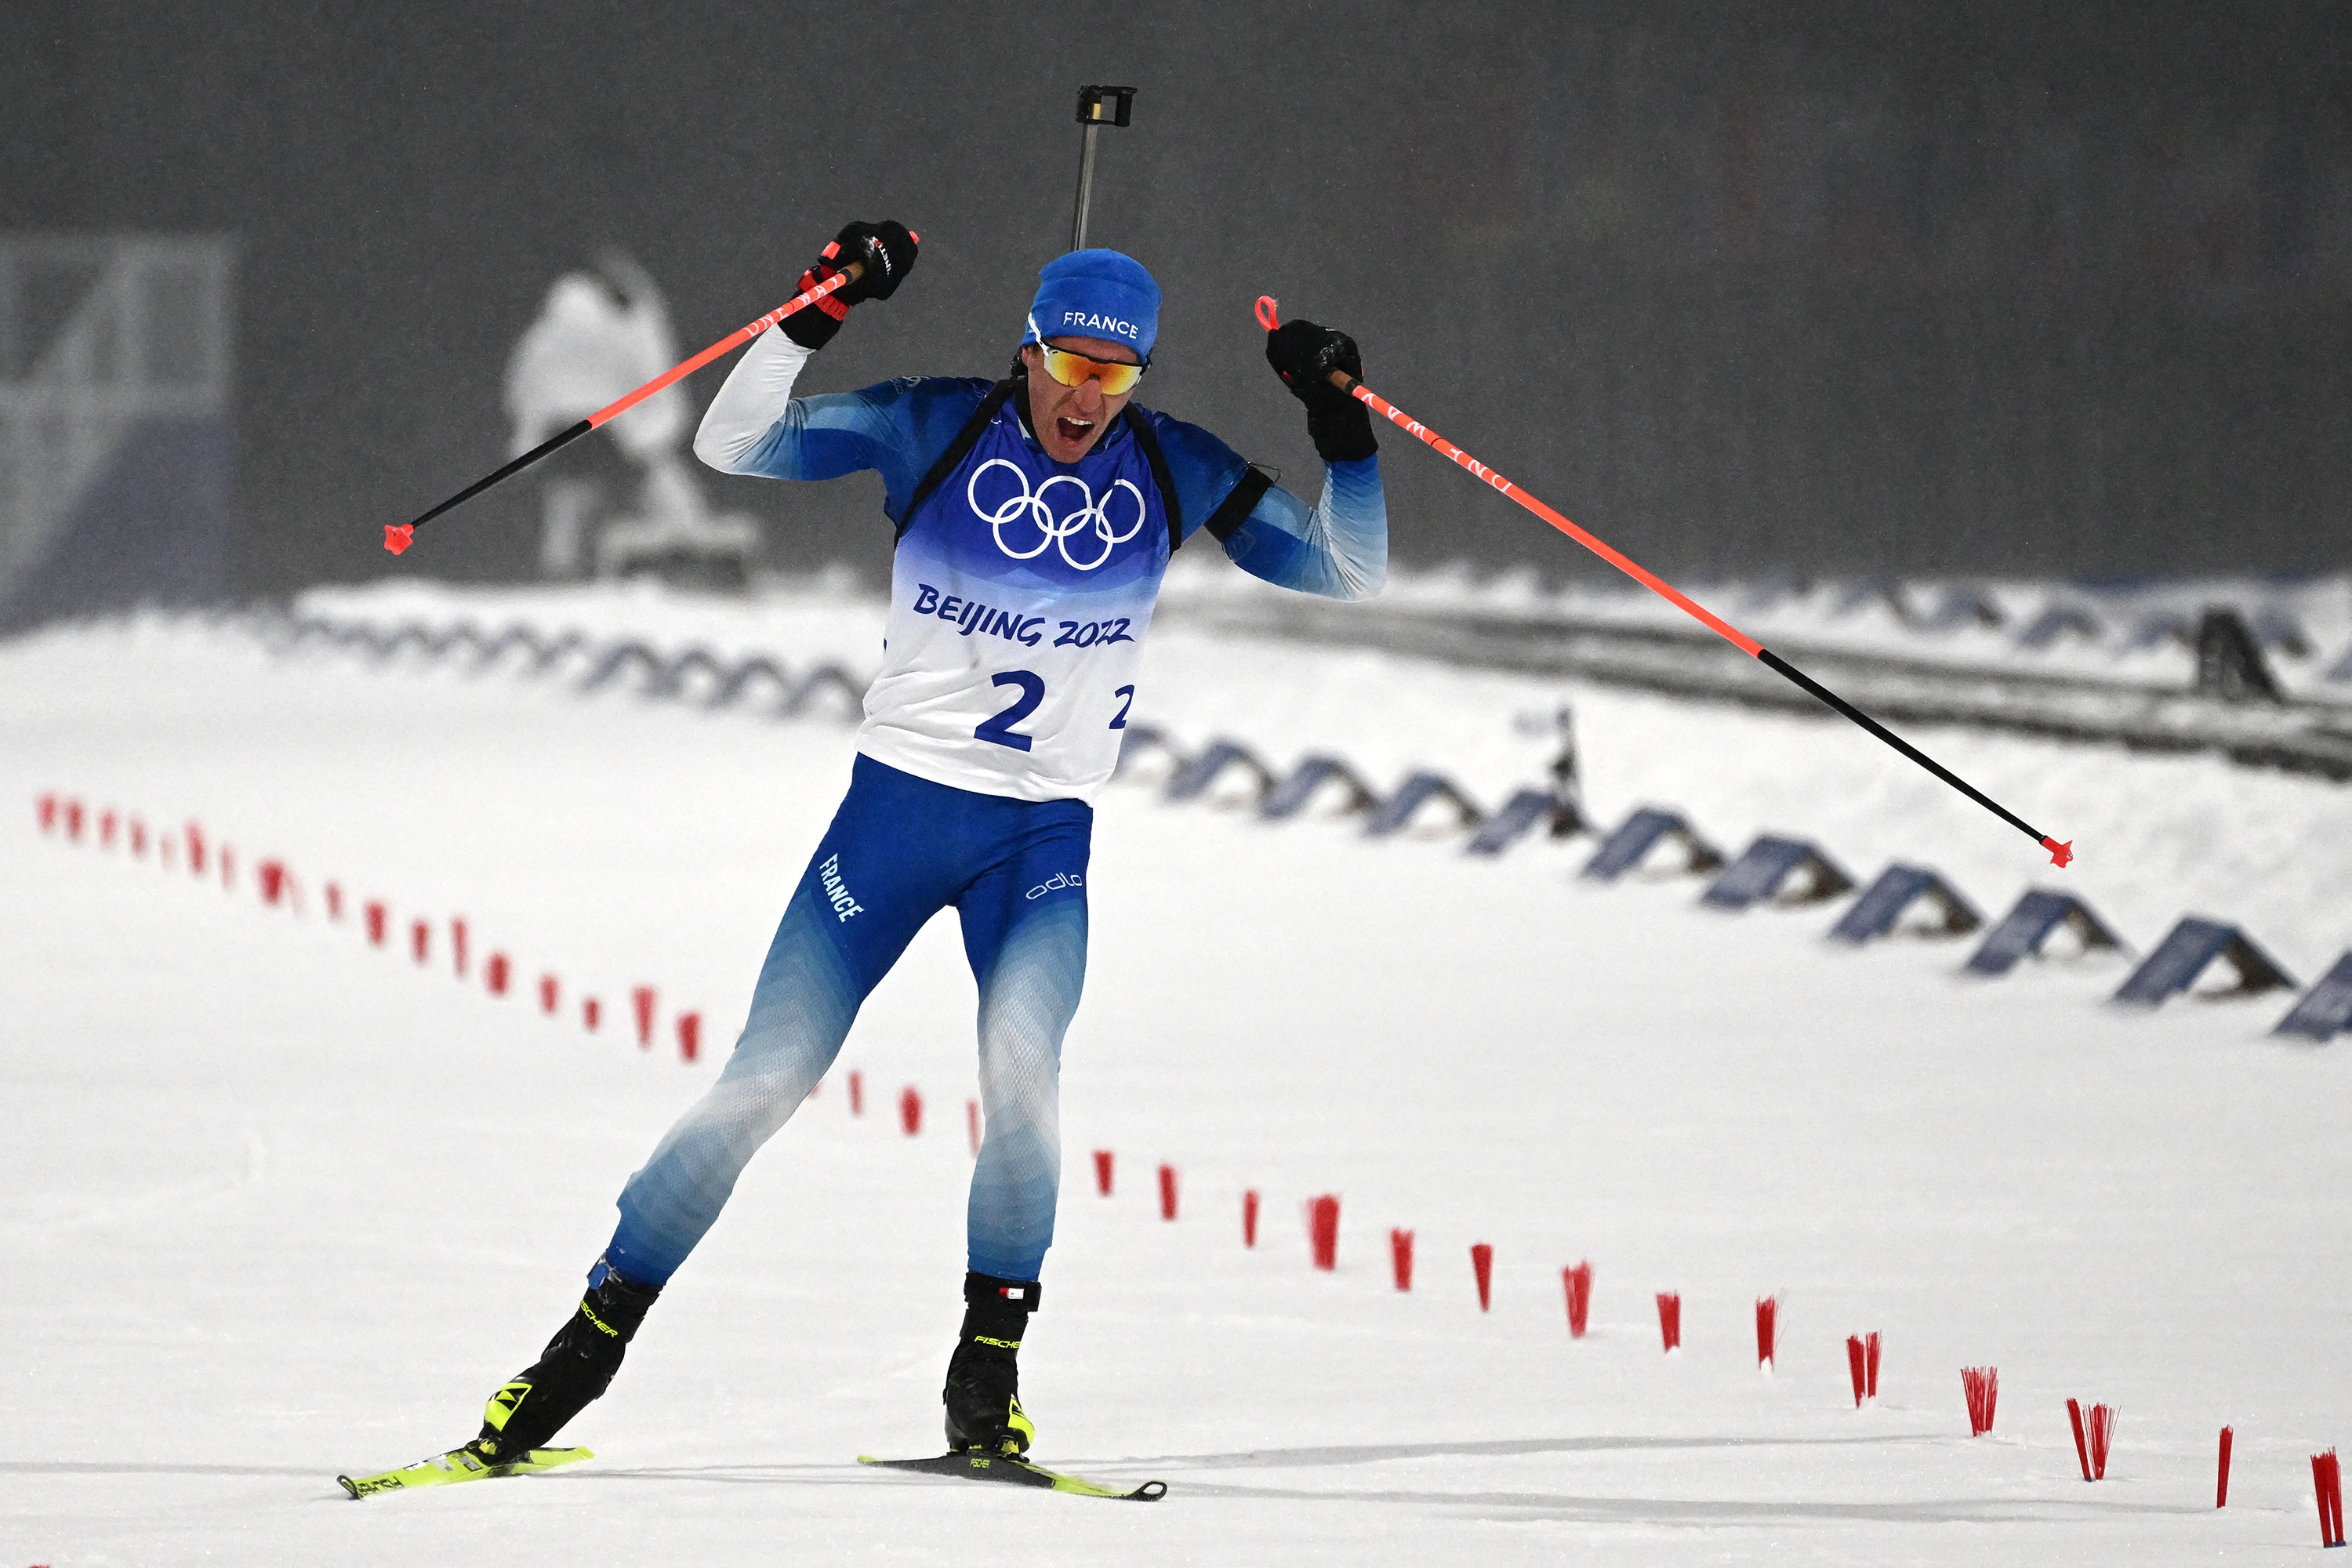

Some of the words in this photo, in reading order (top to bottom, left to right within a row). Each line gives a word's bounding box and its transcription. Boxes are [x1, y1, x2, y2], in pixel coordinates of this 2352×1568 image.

[1063, 311, 1138, 339] FRANCE
[913, 583, 1046, 648] BEIJING
[1053, 618, 1136, 648] 2022
[974, 670, 1046, 753] 2
[1109, 684, 1135, 730] 2
[819, 852, 865, 924] FRANCE
[1025, 872, 1083, 900] odlo
[580, 1300, 619, 1338] ISCHER
[974, 1335, 1021, 1348] FISCHE
